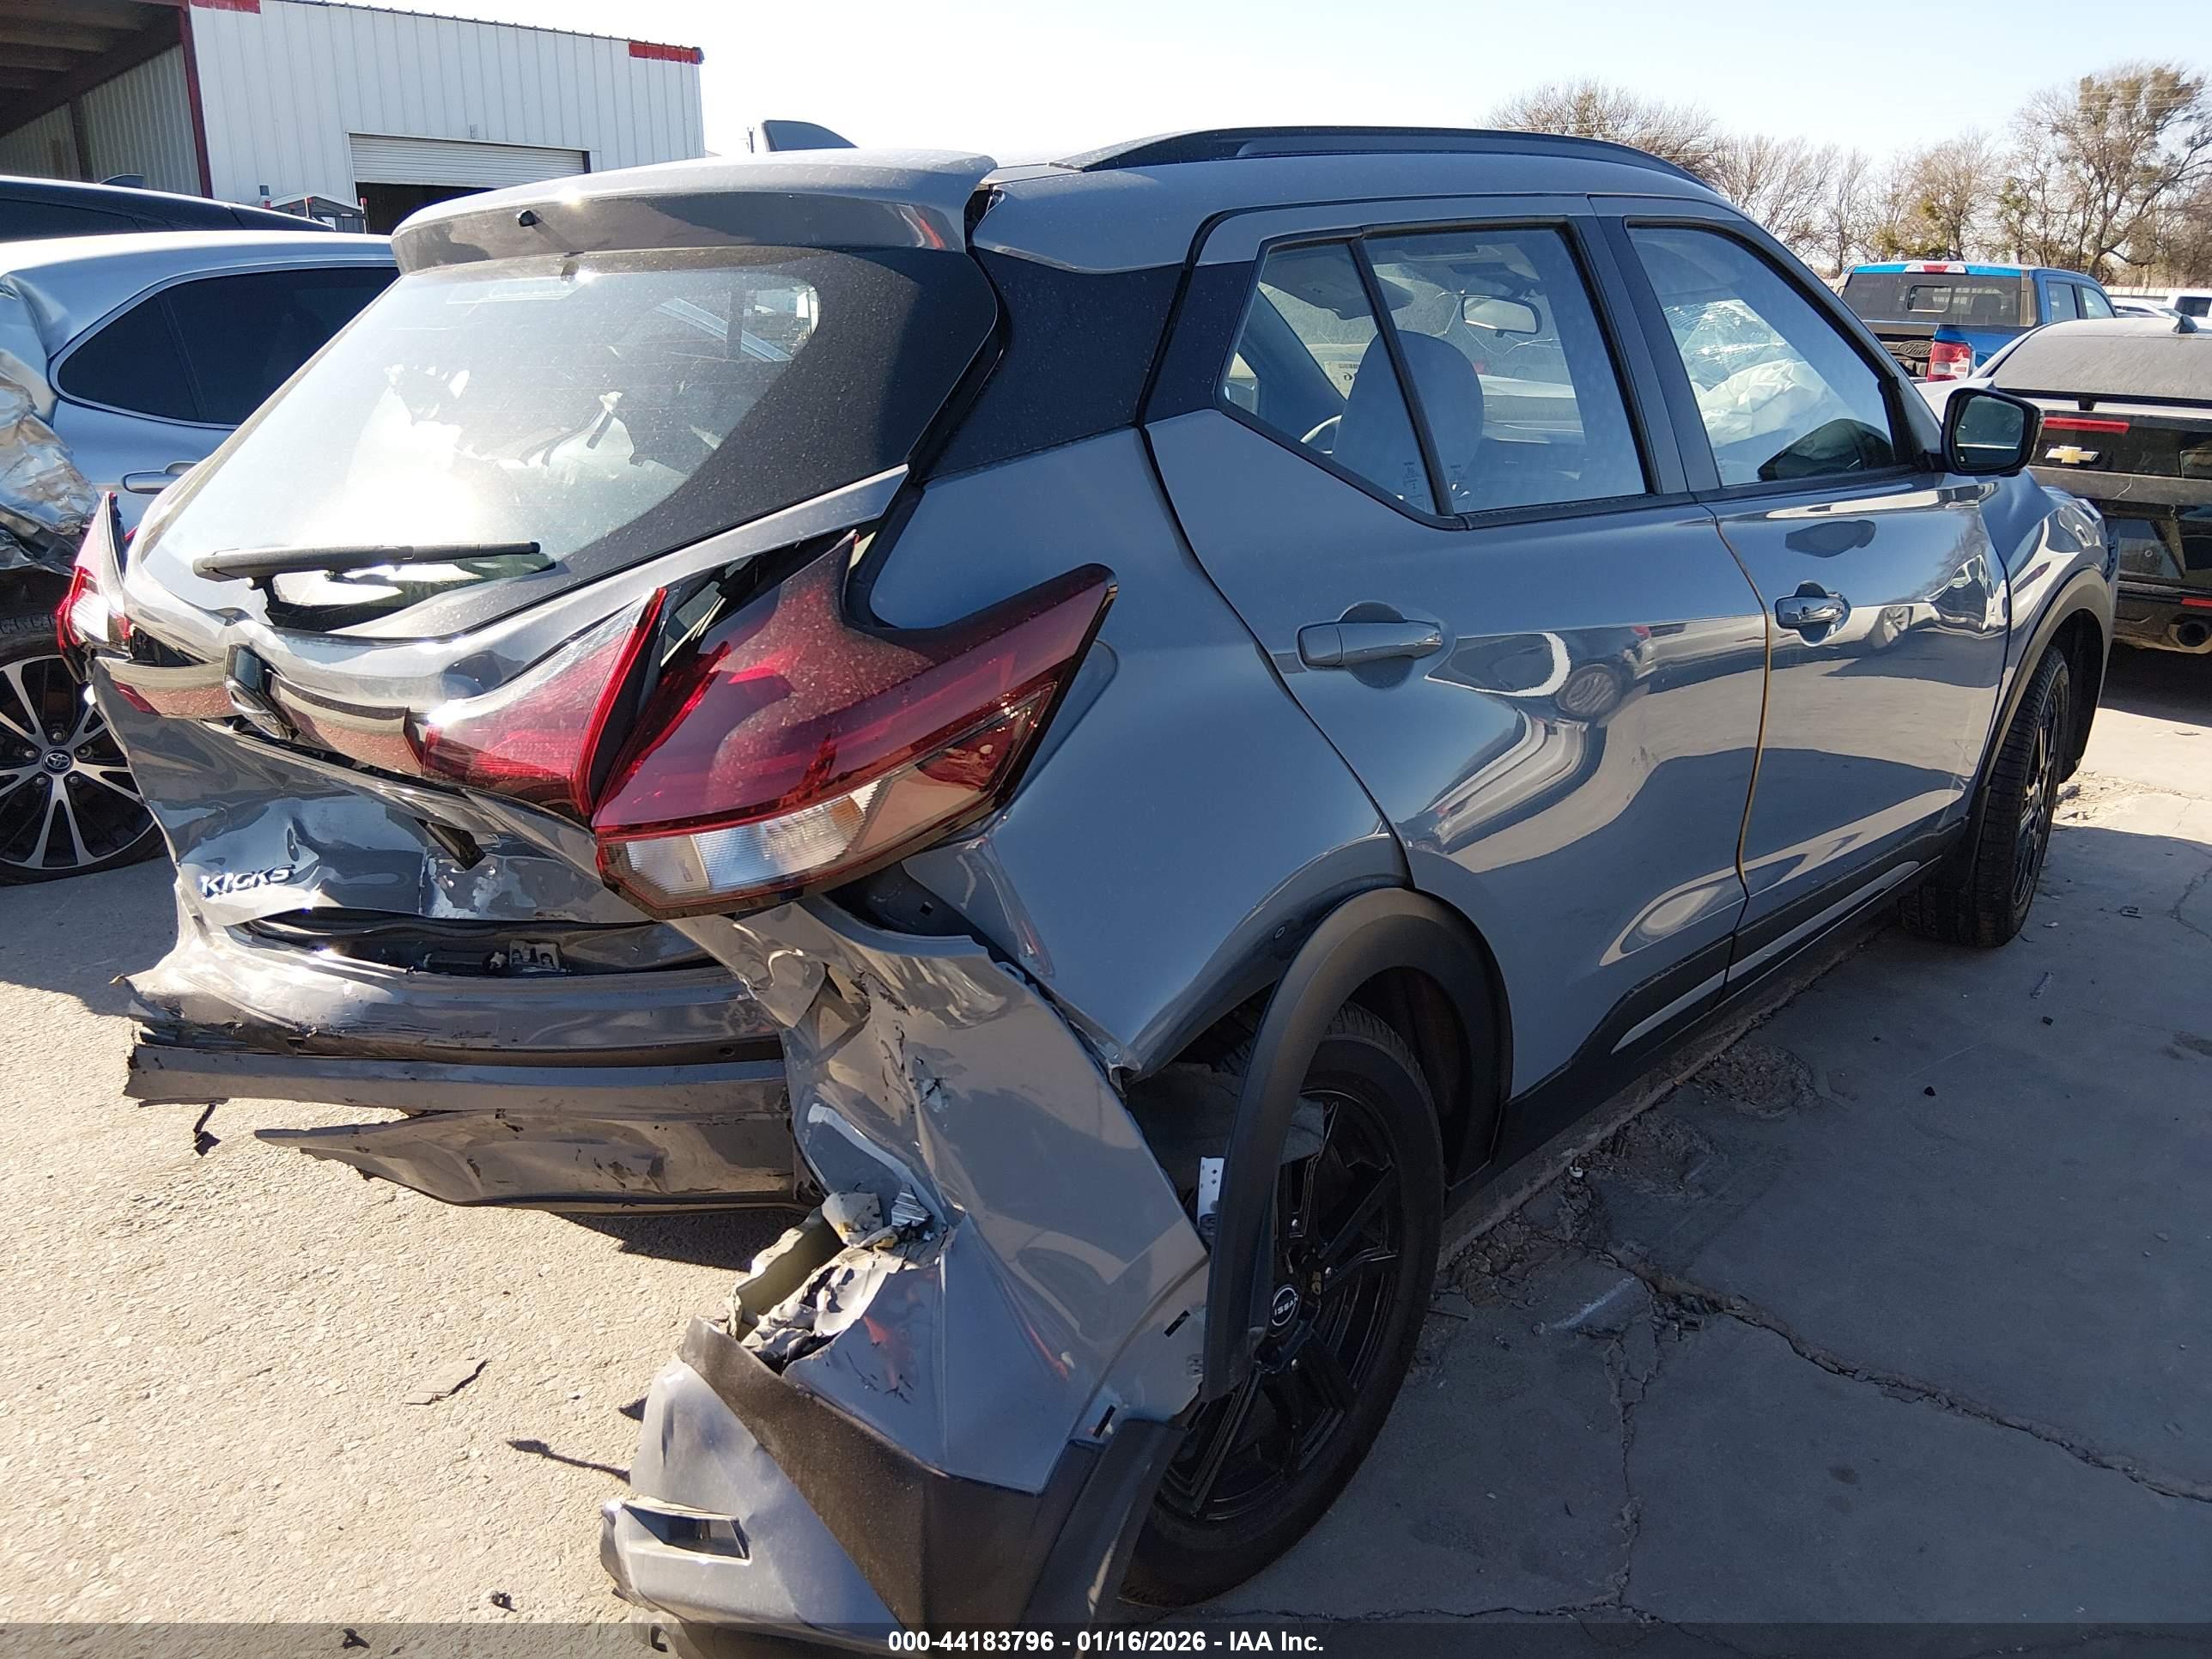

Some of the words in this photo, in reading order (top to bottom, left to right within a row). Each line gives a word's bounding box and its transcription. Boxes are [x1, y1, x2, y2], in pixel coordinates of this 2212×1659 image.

[1904, 343, 1932, 355] Ford
[199, 864, 295, 899] KICKS
[1273, 1293, 1299, 1316] ISSAN
